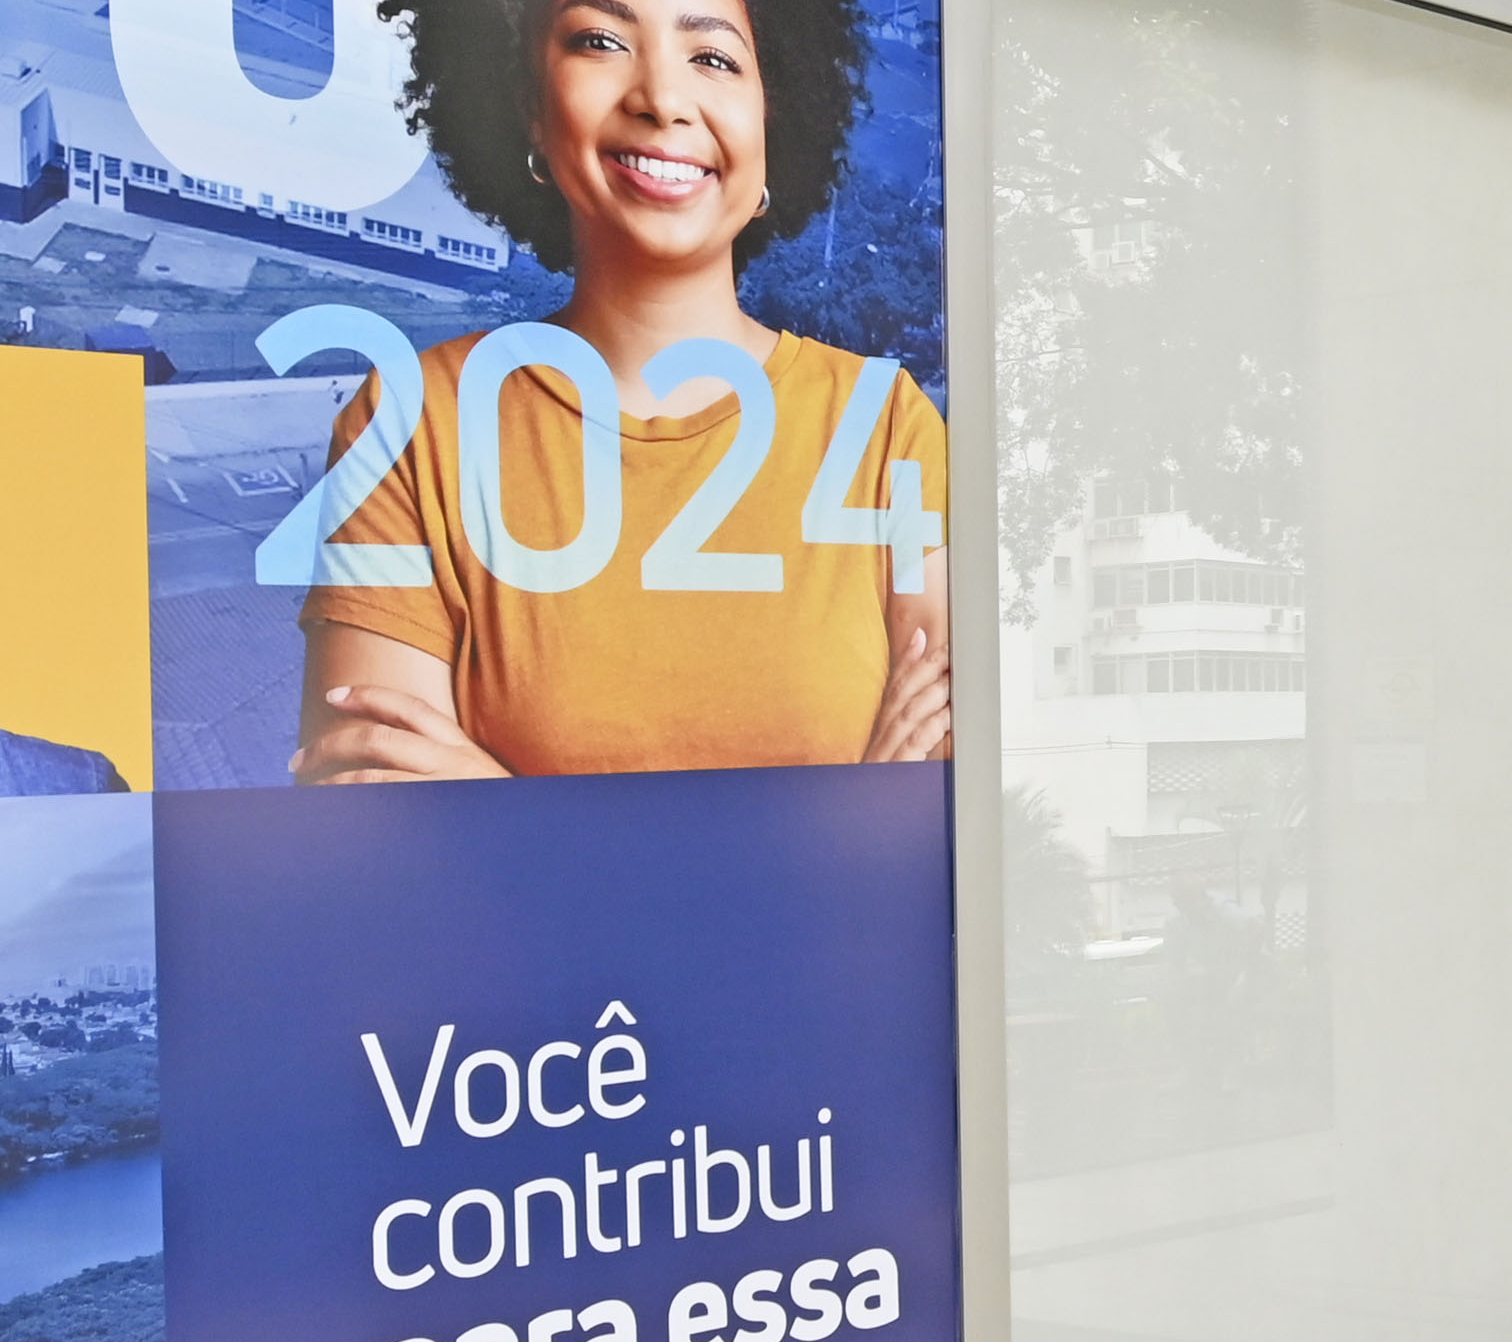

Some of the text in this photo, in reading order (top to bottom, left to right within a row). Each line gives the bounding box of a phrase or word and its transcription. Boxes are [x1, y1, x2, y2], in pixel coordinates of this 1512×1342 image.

[252, 301, 946, 594] 2024
[360, 999, 653, 1150] Você
[372, 1107, 839, 1293] contribui
